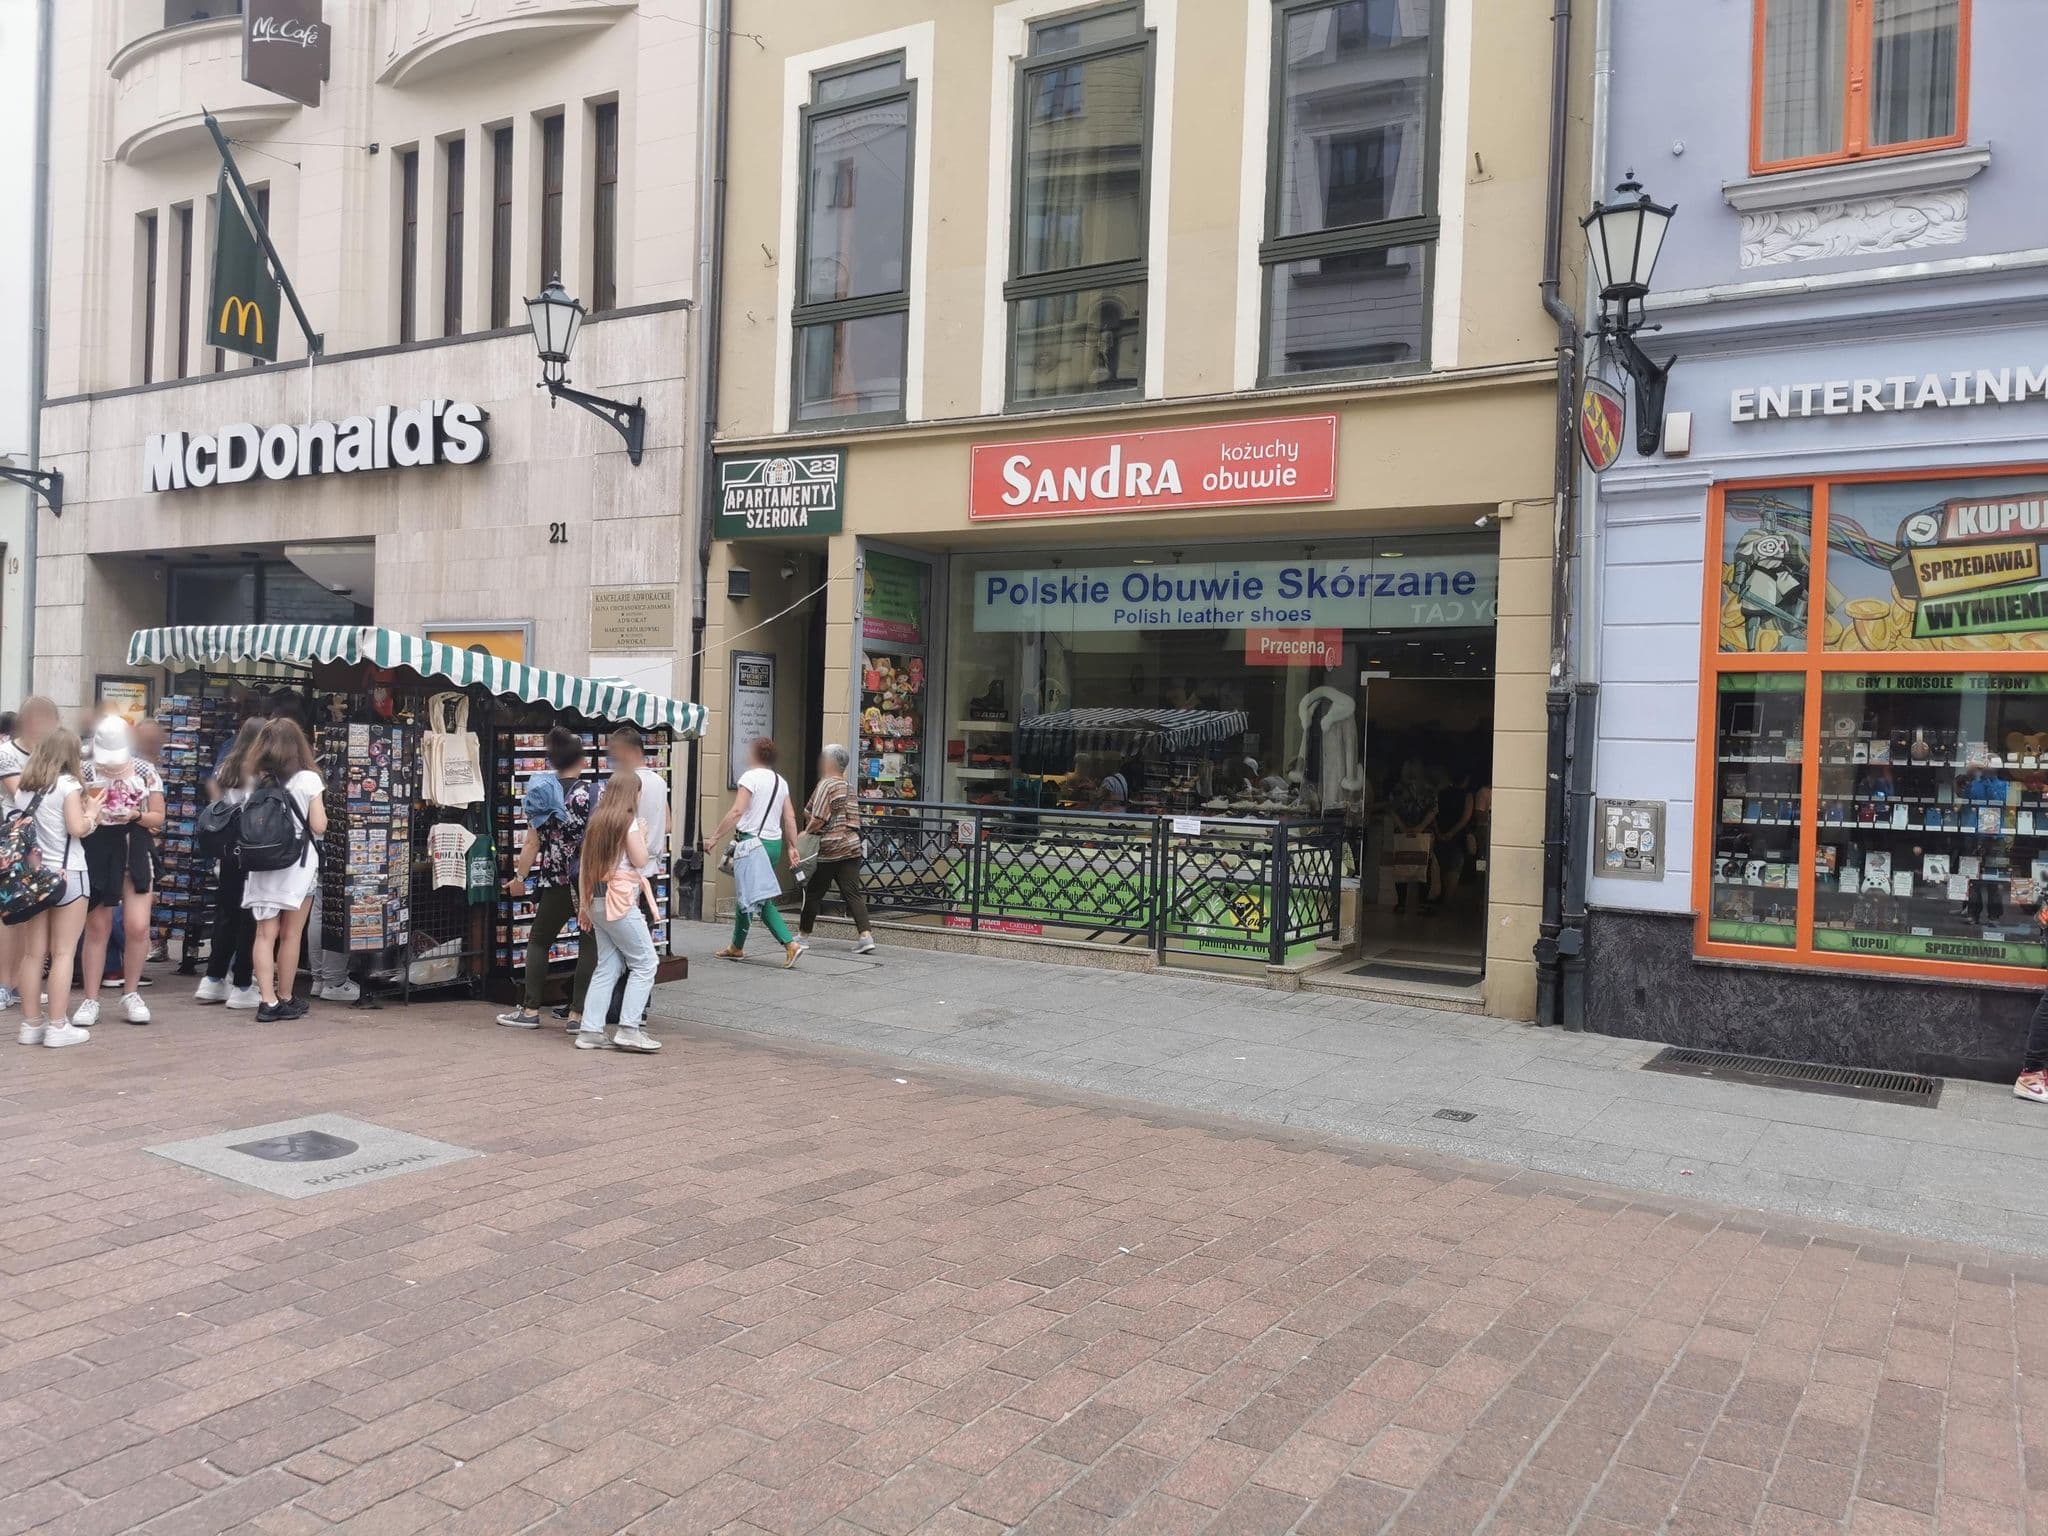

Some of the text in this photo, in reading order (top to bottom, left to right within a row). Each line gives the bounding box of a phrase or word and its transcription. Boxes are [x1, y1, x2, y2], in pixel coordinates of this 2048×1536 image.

[144, 399, 486, 493] McDonald's
[1221, 438, 1299, 462] kożuchy
[810, 459, 836, 473] 23
[1202, 463, 1297, 492] obuwie
[727, 484, 831, 510] APARTAMENTY
[746, 506, 809, 529] SZEROKA
[550, 522, 568, 543] 21
[1919, 549, 2033, 583] SPRZEDAWAJ
[987, 566, 1476, 605] Polskie Obuwie Skórzane
[1114, 607, 1312, 624] Polish leather shoes
[1260, 636, 1325, 655] Przecena
[1856, 676, 1881, 689] GRY
[1897, 676, 1954, 689] KONSOLE
[1851, 936, 1890, 950] KUPUJ
[1925, 942, 2007, 959] SPRZEDAWAJ
